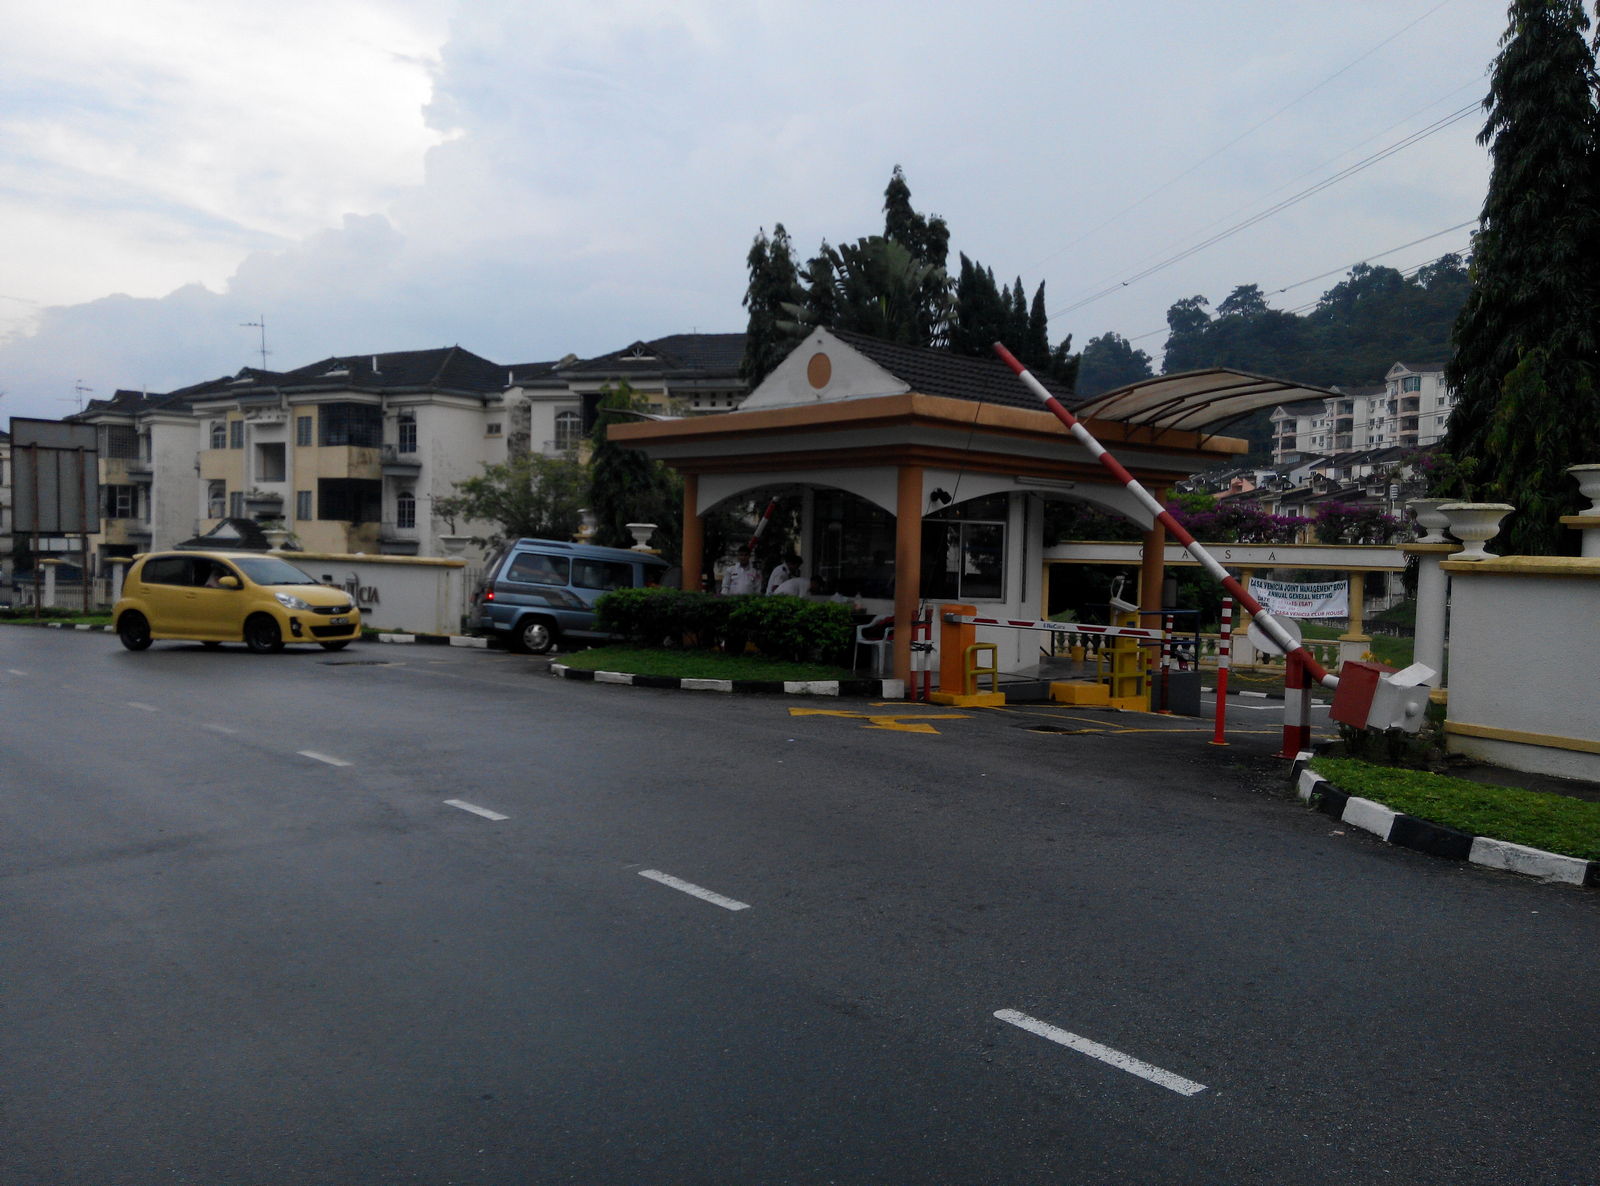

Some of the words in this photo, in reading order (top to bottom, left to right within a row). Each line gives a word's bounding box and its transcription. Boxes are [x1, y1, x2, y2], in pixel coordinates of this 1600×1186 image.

[1251, 579, 1263, 588] CASA
[1264, 582, 1283, 591] VENICIA
[1284, 584, 1299, 592] JOINT
[1300, 584, 1333, 592] MANAGEMENT
[1333, 581, 1347, 590] BODY
[1268, 591, 1287, 599] ANNUAL
